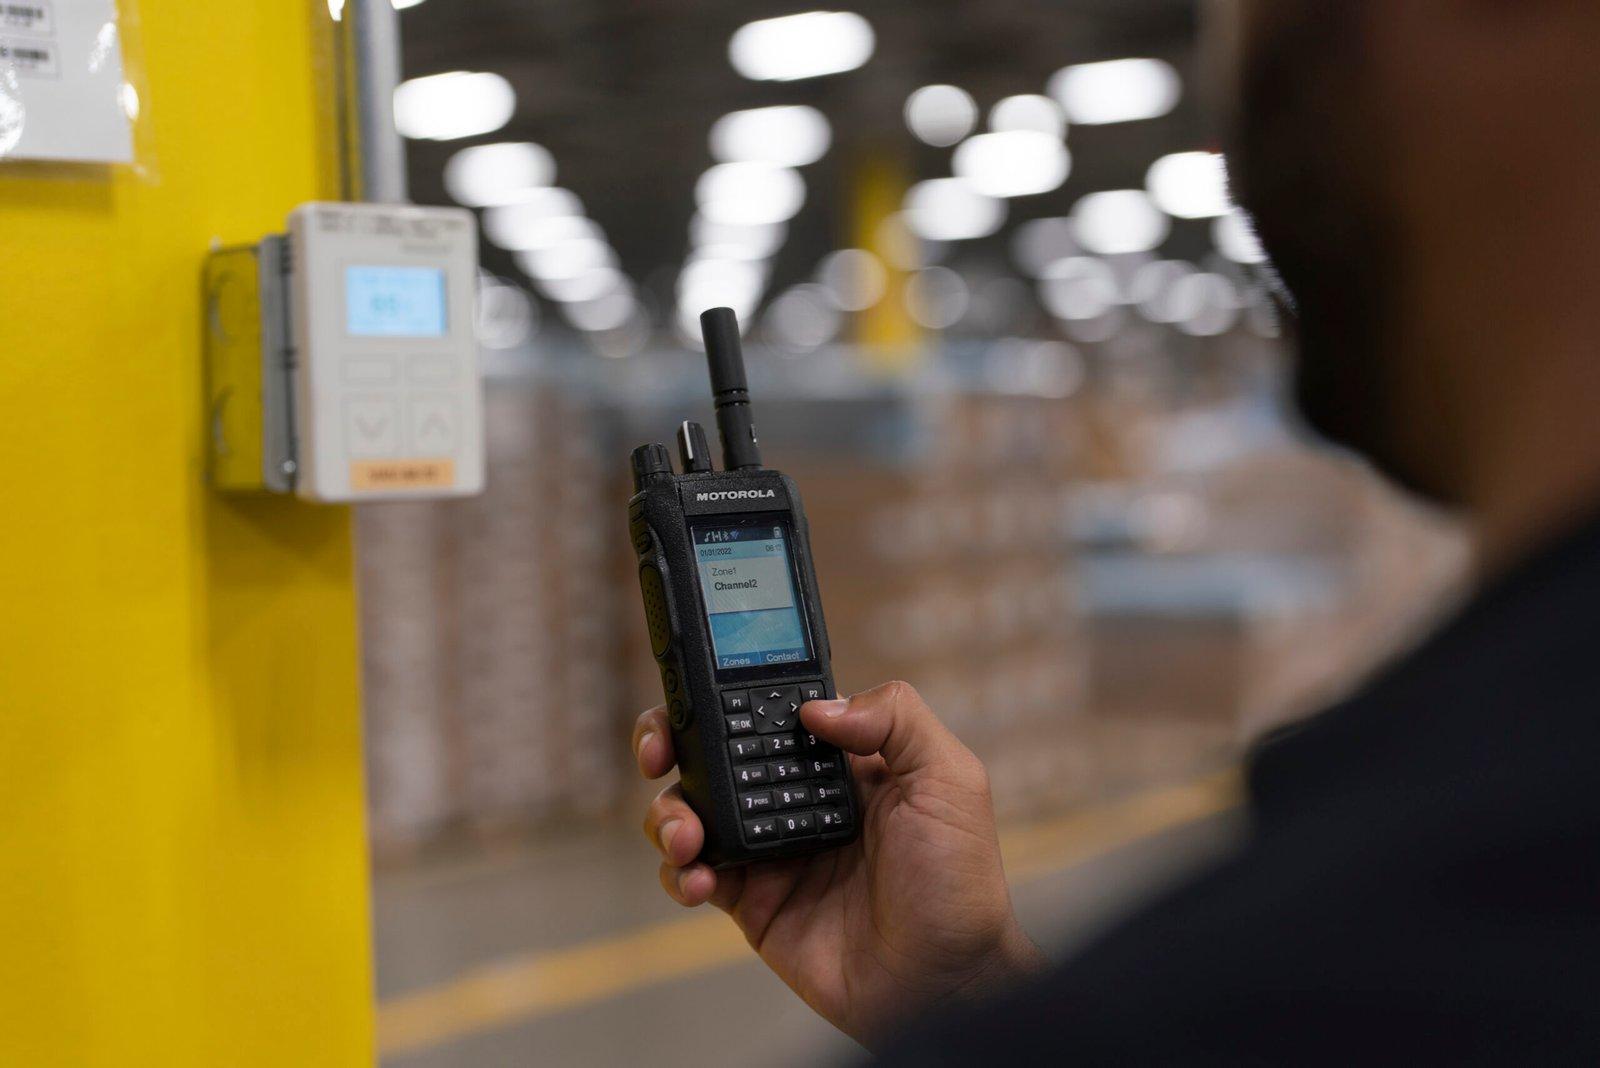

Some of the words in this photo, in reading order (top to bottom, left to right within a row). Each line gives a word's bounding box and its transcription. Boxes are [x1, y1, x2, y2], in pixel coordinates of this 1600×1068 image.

[697, 489, 775, 501] MOTOROLA
[700, 547, 732, 556] 01/31/2022
[712, 567, 736, 577] Zone1
[714, 579, 758, 591] Channel2
[723, 656, 751, 667] Zones
[766, 652, 801, 663] Contact
[809, 690, 818, 698] P2
[732, 698, 741, 707] P1
[740, 720, 752, 729] OK
[773, 738, 781, 749] 2
[808, 734, 816, 745] 3
[737, 743, 743, 754] 1
[778, 765, 786, 776] 5
[814, 761, 821, 772] 6
[741, 770, 749, 781] 4
[783, 792, 791, 803] 8
[819, 788, 826, 798] 9
[745, 797, 753, 809] 7
[787, 819, 795, 830] 0
